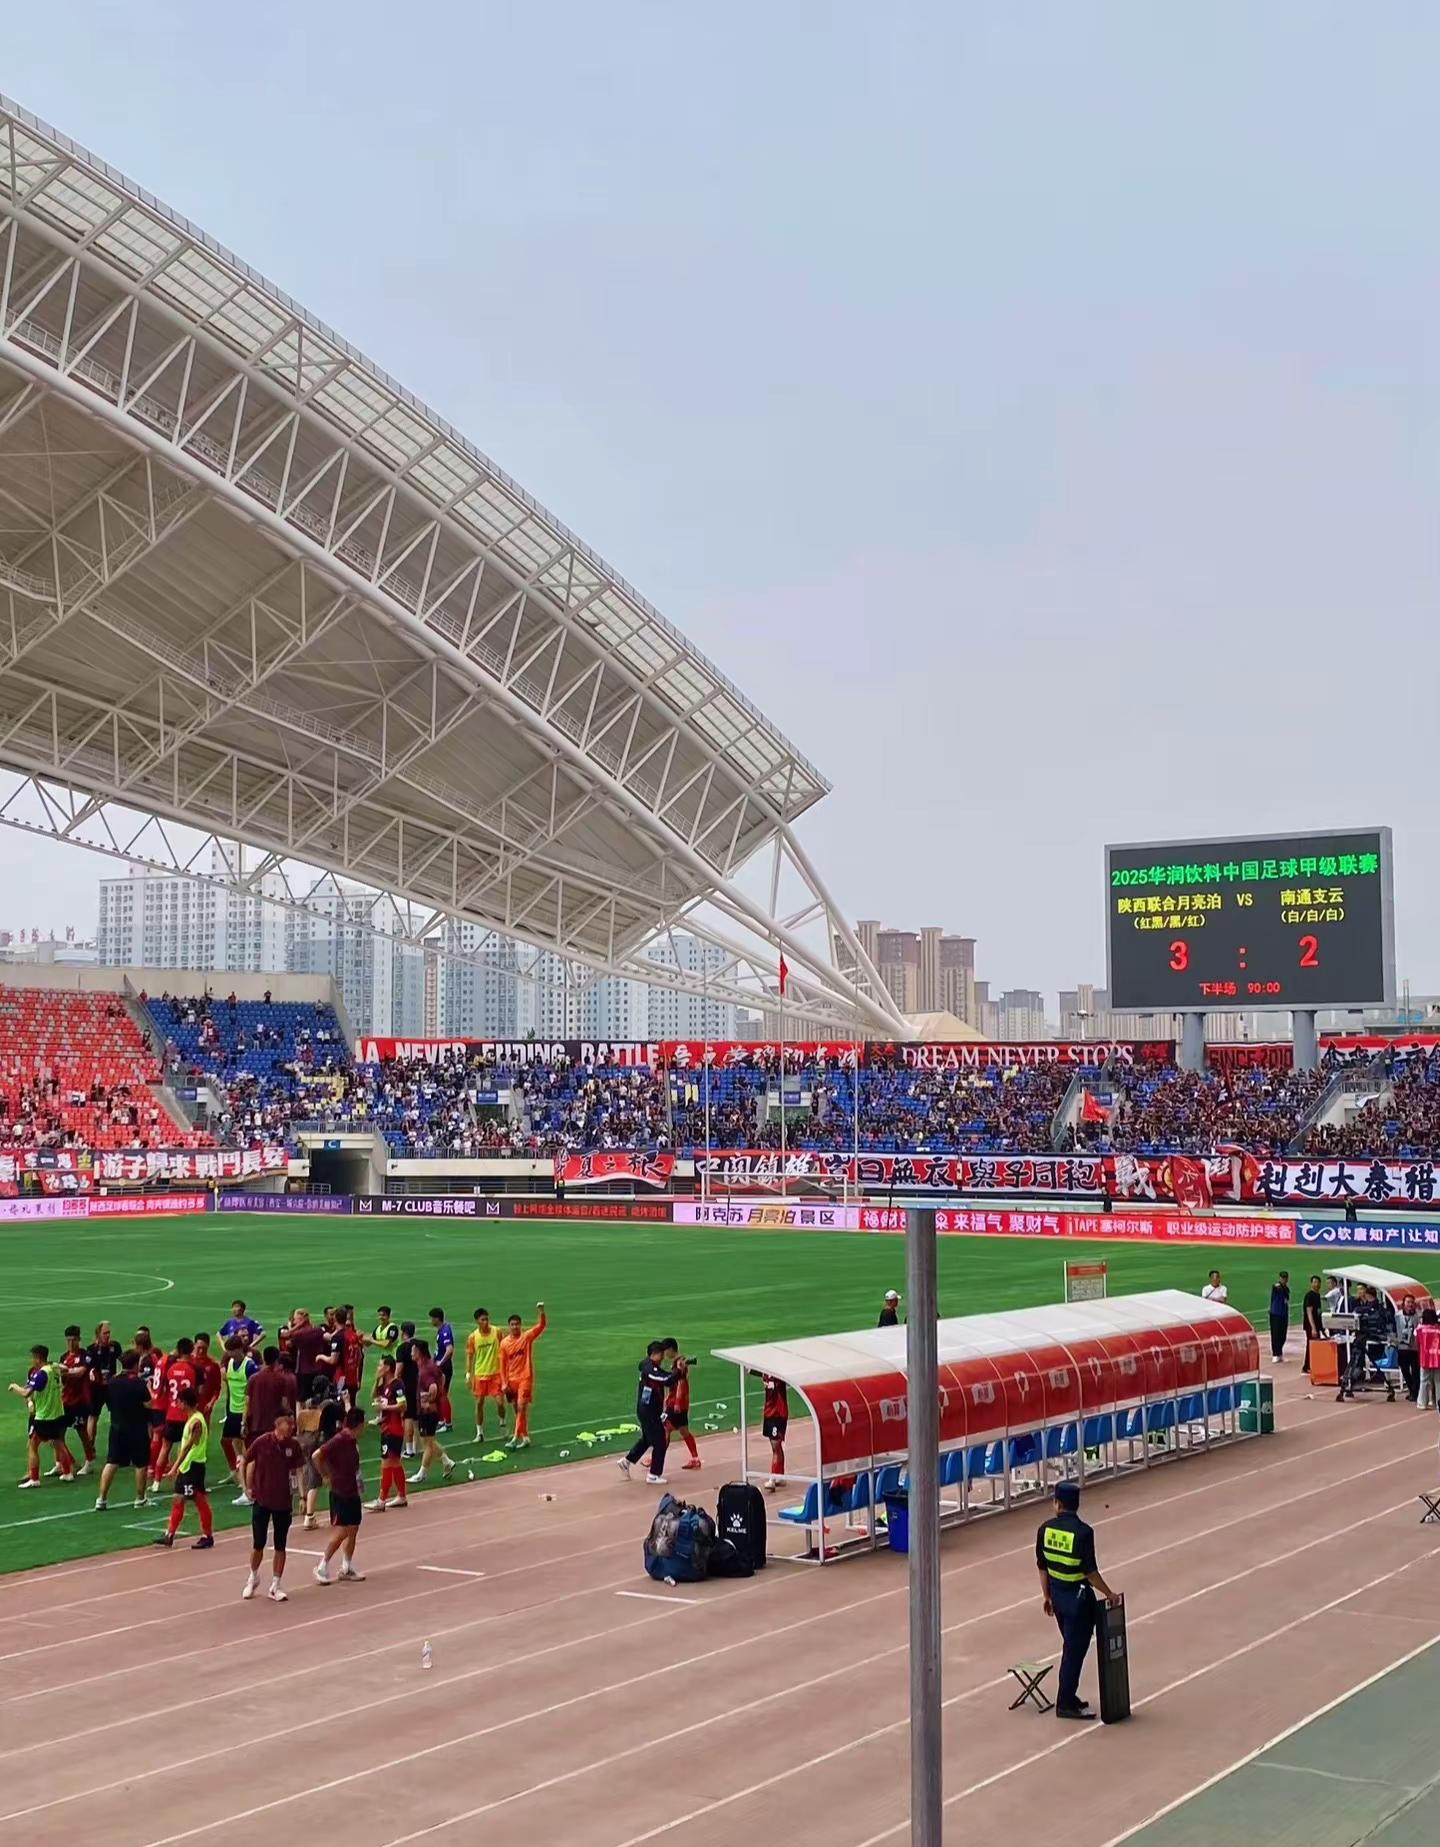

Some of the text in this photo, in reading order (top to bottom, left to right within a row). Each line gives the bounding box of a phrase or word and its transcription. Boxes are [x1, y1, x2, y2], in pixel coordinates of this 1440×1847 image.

[1112, 853, 1378, 886] 2025华润饮料中国足球甲级联赛
[1117, 887, 1344, 914] 陕西联合月亮泊 VS 南通支云
[1169, 941, 1189, 971] 3
[1299, 935, 1319, 968] 2
[1199, 982, 1280, 996] 下半场 90:00
[902, 1046, 981, 1068] DREAM
[382, 1201, 402, 1212] M-7
[953, 1213, 1003, 1232] 来福气
[1009, 1215, 1060, 1234] 聚财气
[1166, 1221, 1293, 1240] 职业级运动防护装备
